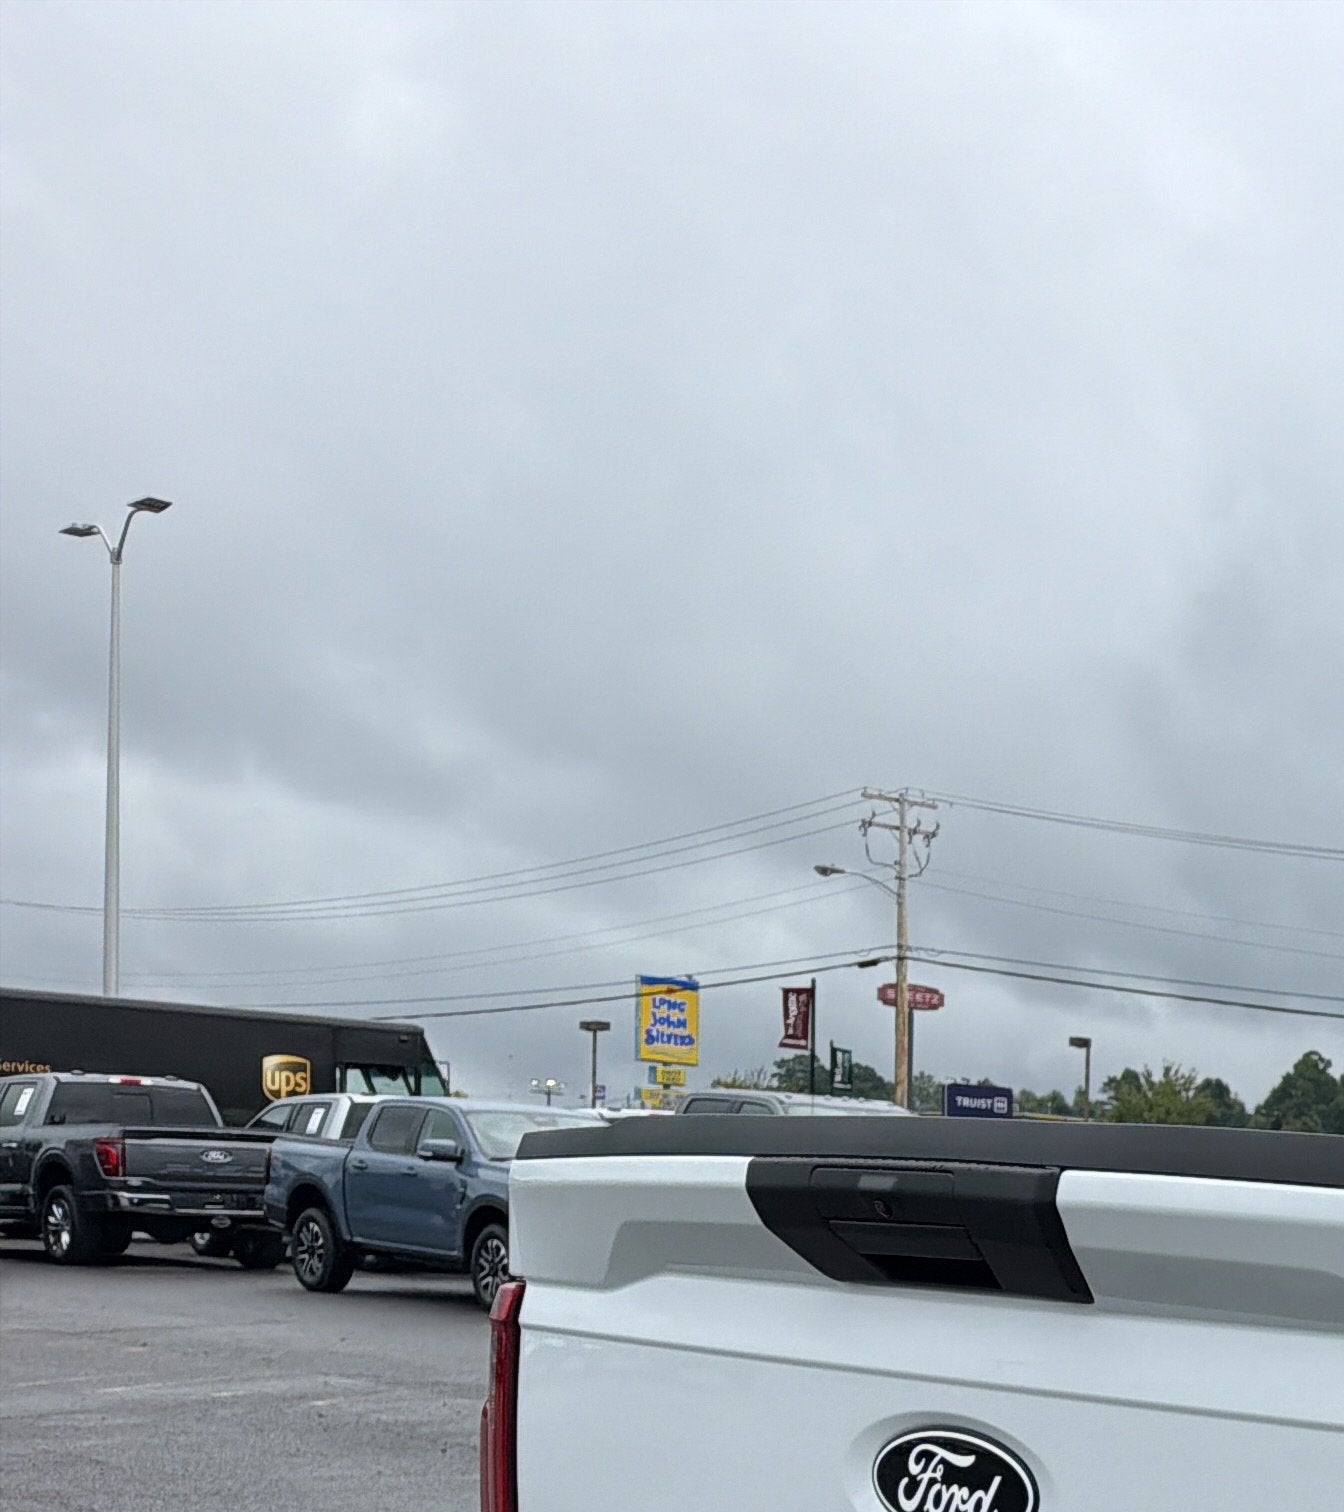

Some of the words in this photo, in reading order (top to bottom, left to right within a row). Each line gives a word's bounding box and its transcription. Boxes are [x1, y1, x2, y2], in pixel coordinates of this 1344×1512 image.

[886, 988, 941, 1003] SEETZ
[0, 1060, 51, 1073] ervices
[955, 1096, 993, 1109] TRUIST
